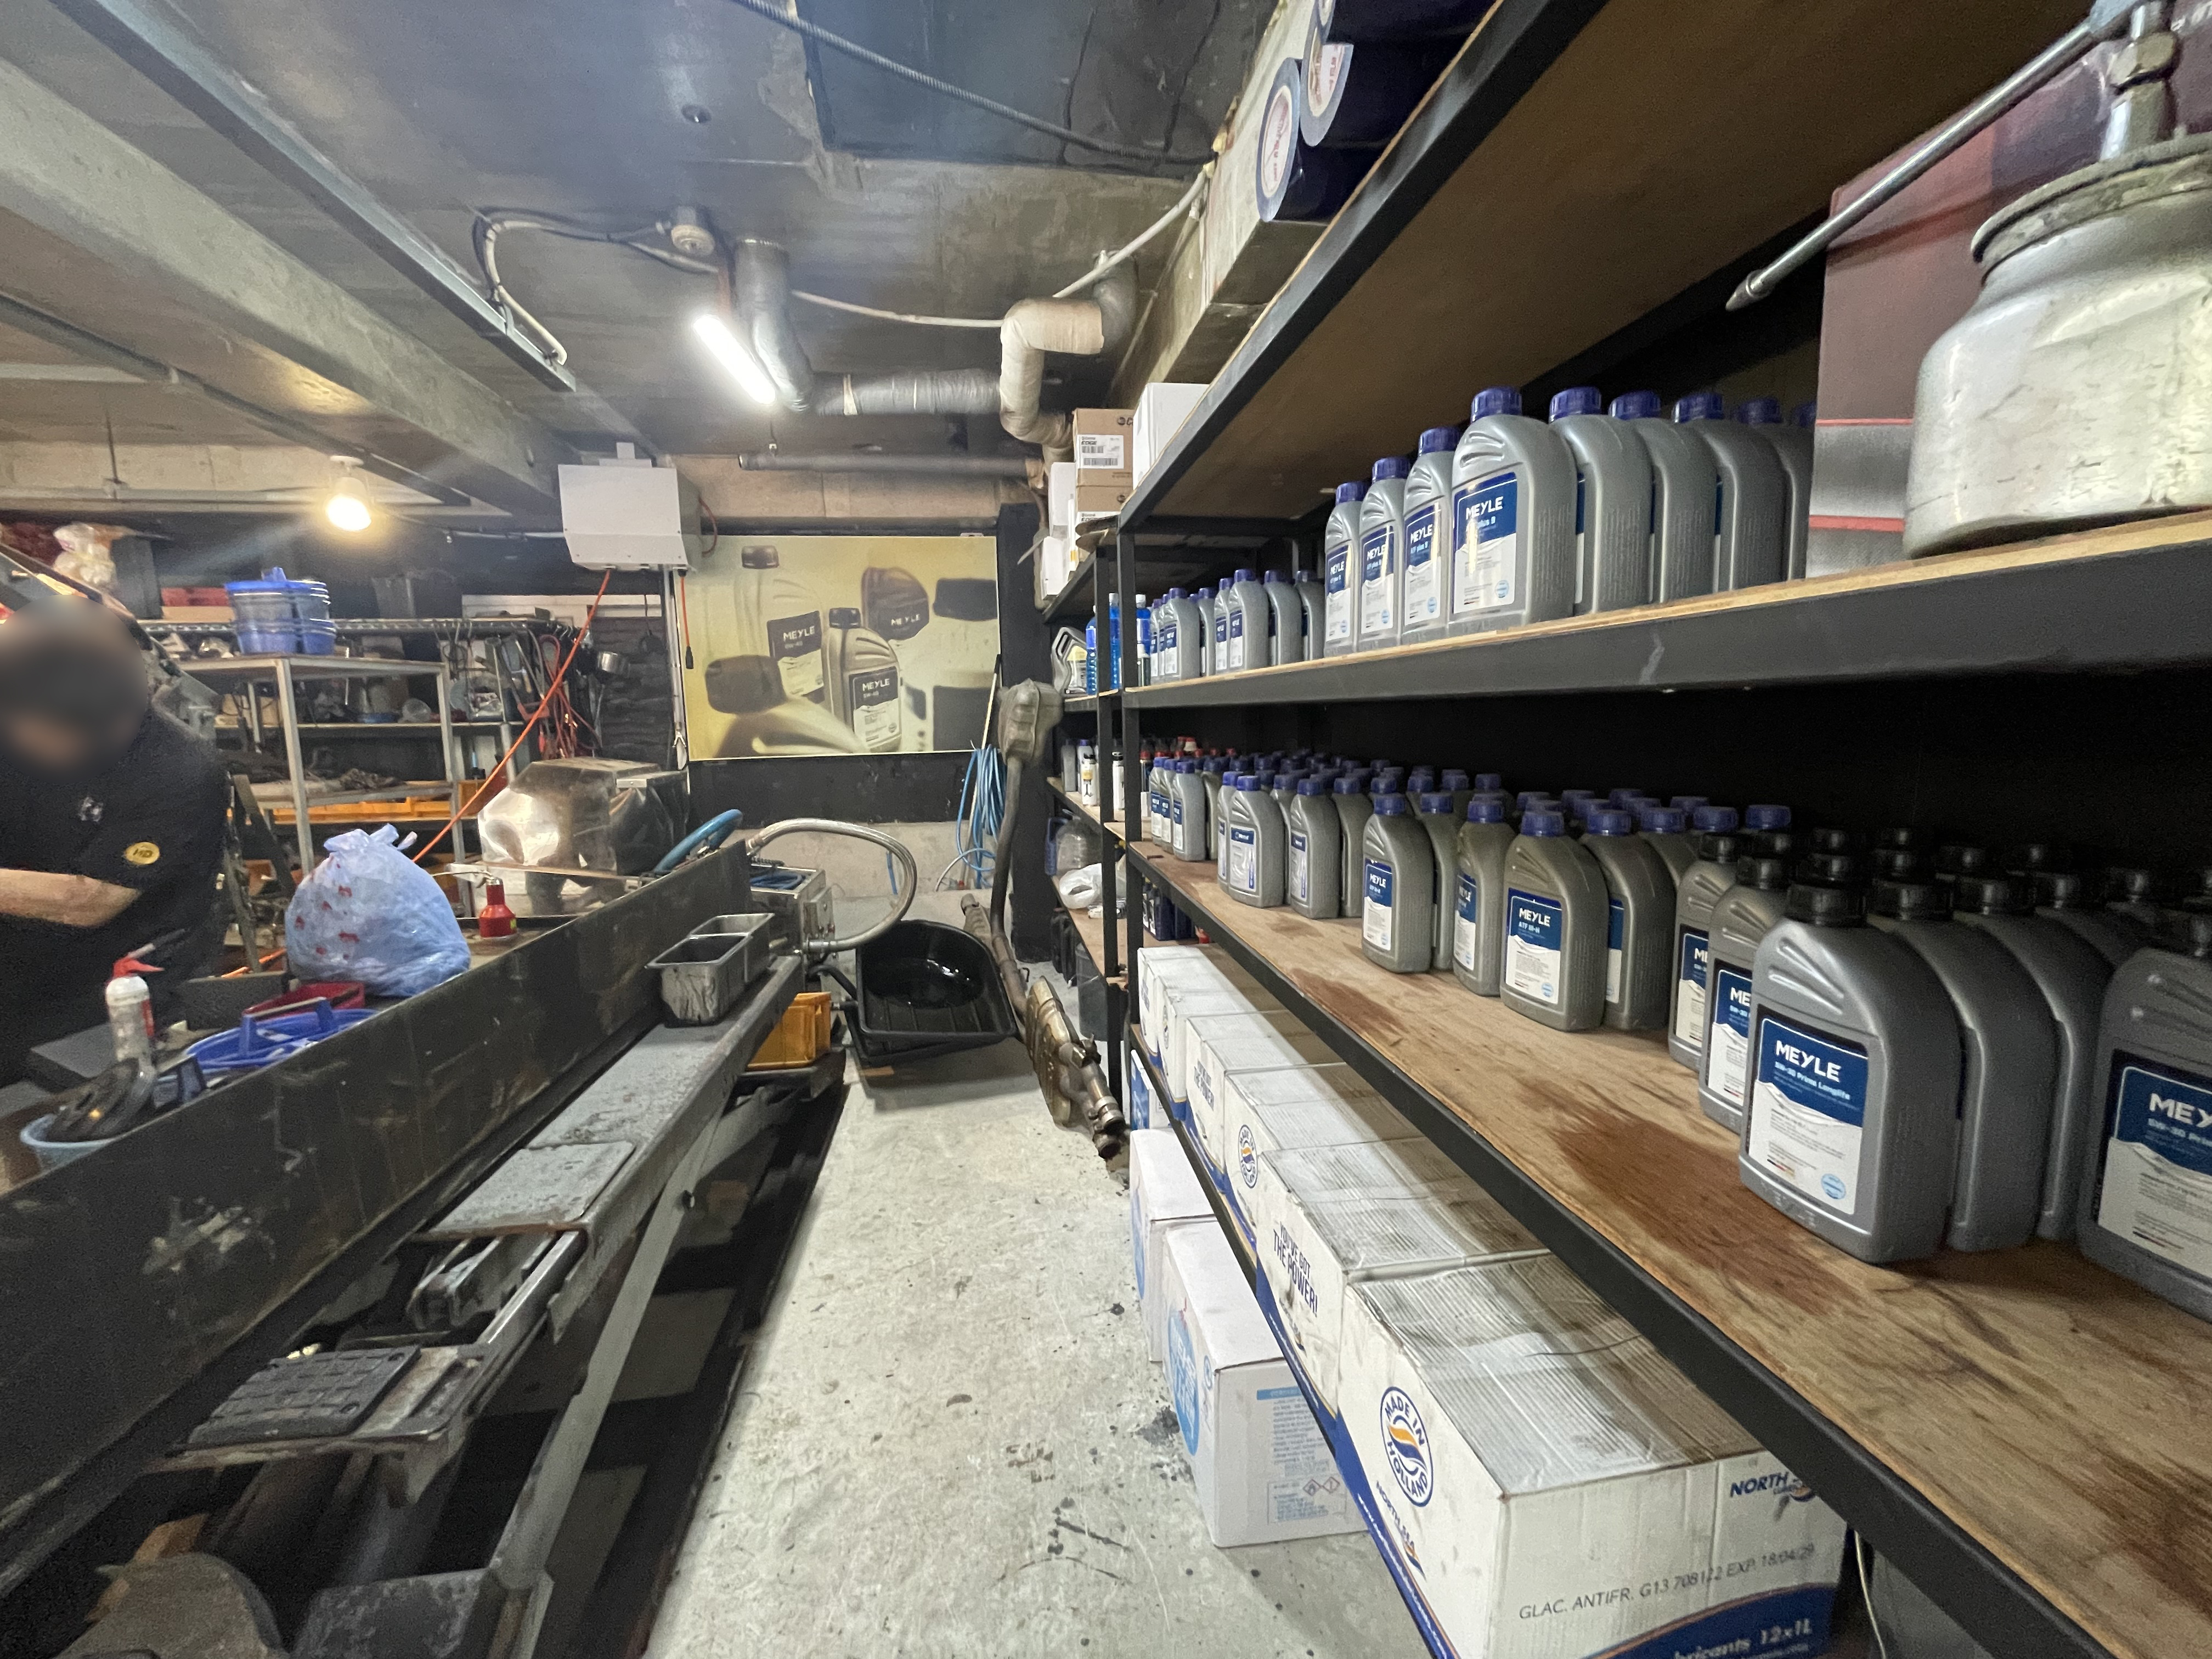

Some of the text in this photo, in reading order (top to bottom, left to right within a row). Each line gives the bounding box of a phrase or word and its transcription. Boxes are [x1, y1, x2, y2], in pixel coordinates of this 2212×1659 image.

[1466, 496, 1504, 520] MEYLE
[1410, 523, 1433, 544] MEYLE
[1367, 544, 1386, 561] MEYLE
[1330, 561, 1345, 575] MEYLE
[891, 614, 921, 626] MEYLE
[783, 625, 815, 642] MEYLE
[862, 678, 890, 691] MEYLE
[1370, 873, 1386, 888] MEYLE
[1519, 907, 1551, 927] MEYLE
[1775, 1040, 1842, 1083] MEYLE
[1273, 1228, 1286, 1267] THE
[1288, 1252, 1318, 1318] POWER!
[1299, 1251, 1310, 1279] GOT
[1385, 1395, 1425, 1446] MADE IN
[1387, 1441, 1428, 1498] HOLLAND
[1730, 1471, 1789, 1498] NORTH
[1519, 1599, 1567, 1619] GLAC.
[1572, 1587, 1634, 1611] ANTIFR.
[1639, 1578, 1669, 1598] G13
